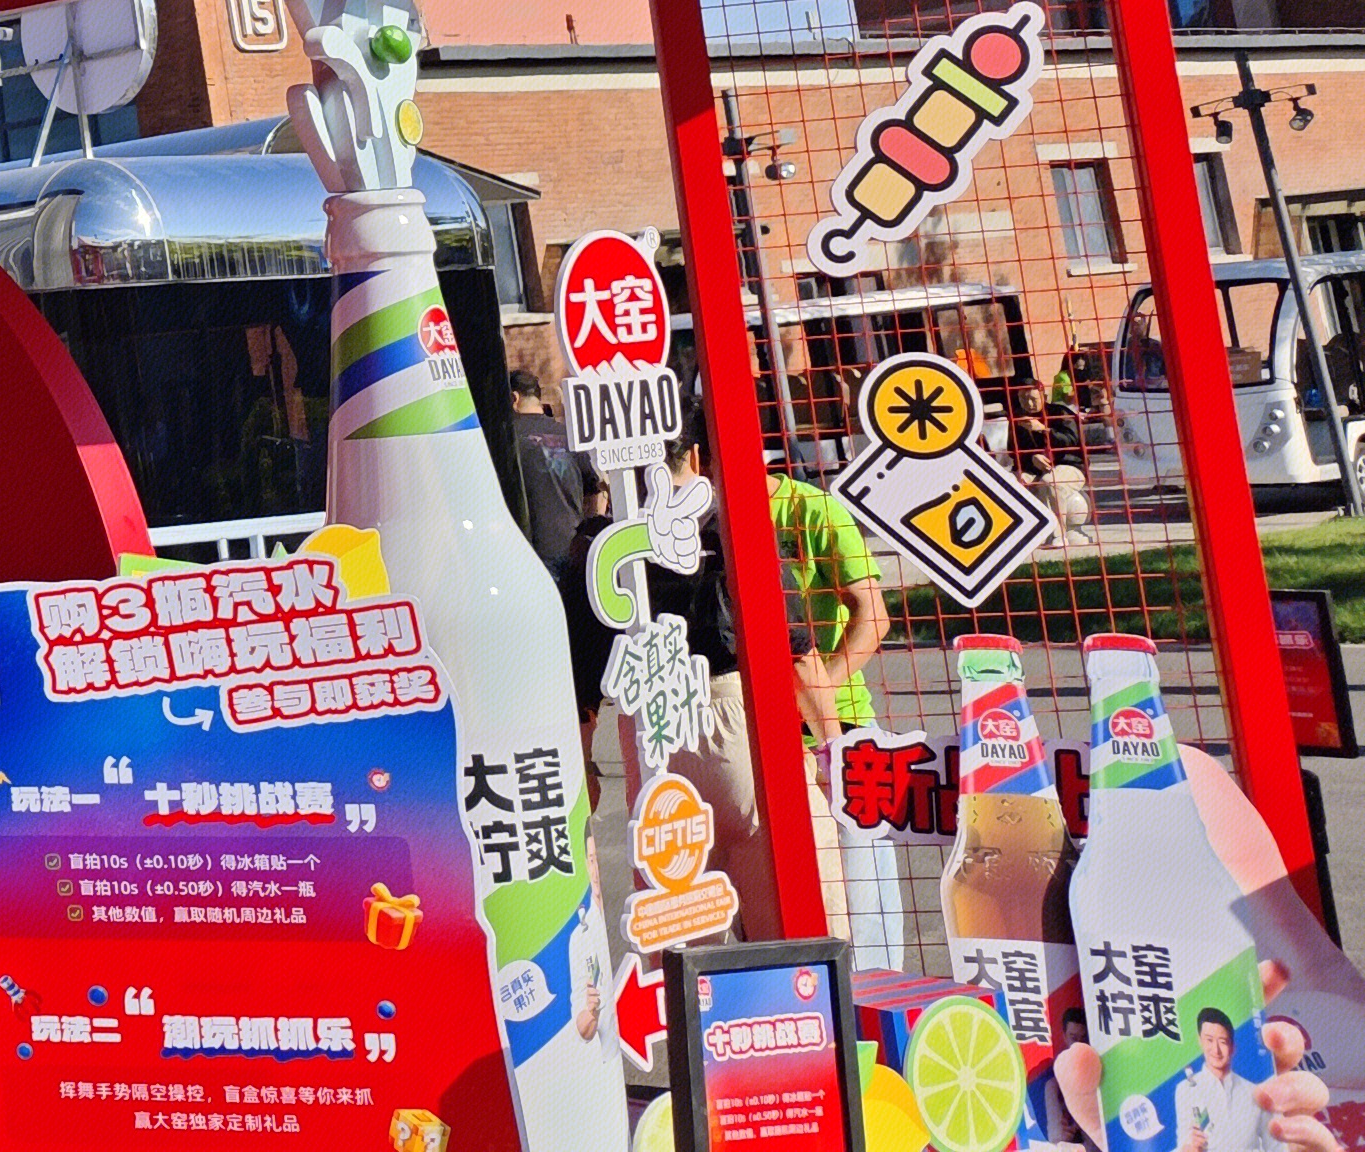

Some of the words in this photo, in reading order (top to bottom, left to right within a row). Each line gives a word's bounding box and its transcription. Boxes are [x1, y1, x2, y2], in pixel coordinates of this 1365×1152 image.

[569, 275, 658, 348] 大窑
[571, 373, 679, 445] DAYAO
[599, 446, 635, 465] SINCE
[637, 443, 664, 461] 1983
[40, 562, 336, 640] 购3瓶汽水
[52, 606, 419, 690] 解锁嗨玩福利
[612, 622, 686, 707] 含真实
[232, 671, 438, 724] 参与即获奖
[980, 742, 1027, 760] DAYAO
[982, 718, 1018, 737] 大窑
[1111, 739, 1160, 757] DAYAO
[1112, 716, 1152, 735] 大窑
[463, 747, 566, 814] 大窑
[472, 814, 575, 884] 柠爽
[641, 813, 707, 857] CIFTIS
[962, 948, 1042, 995] 大窑
[1090, 940, 1174, 991] 大窑
[1095, 989, 1182, 1042] 柠爽
